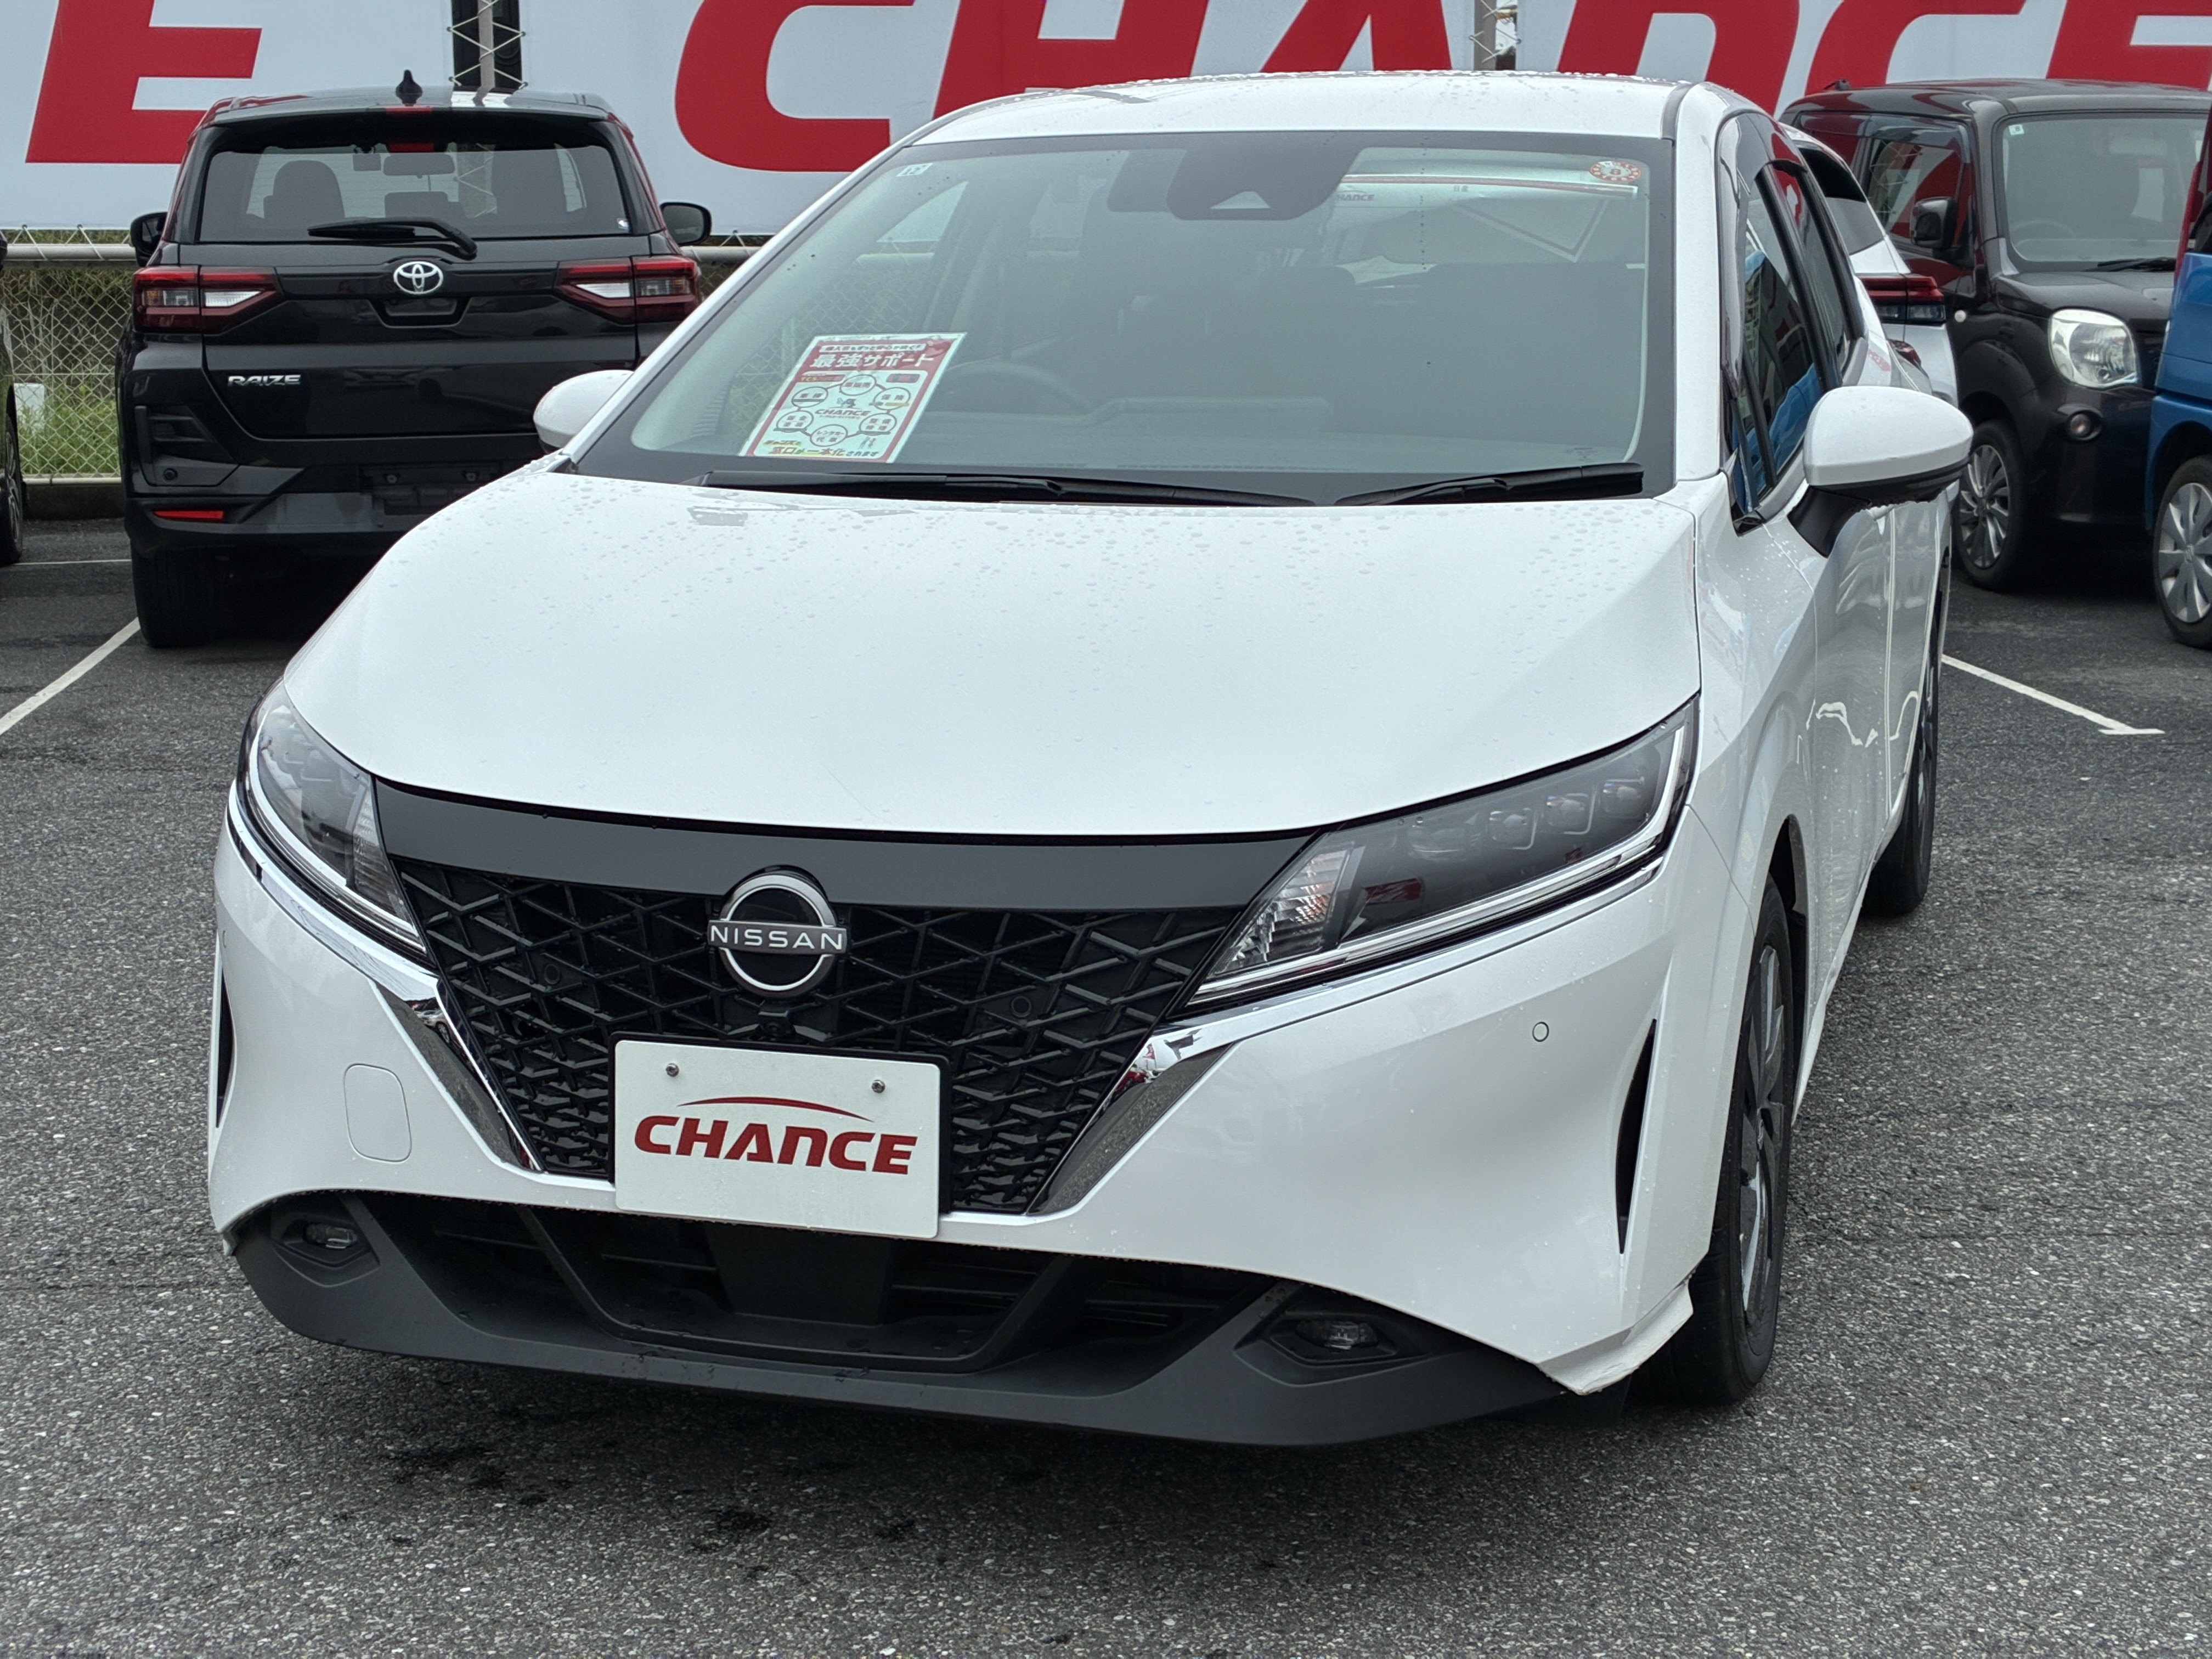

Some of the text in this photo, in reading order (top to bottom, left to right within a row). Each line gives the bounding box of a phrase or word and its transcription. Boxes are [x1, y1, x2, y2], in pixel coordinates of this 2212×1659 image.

[811, 353, 934, 368] 最強サポート
[227, 374, 301, 387] RAIZE
[710, 924, 843, 950] NISSAN
[634, 1115, 918, 1175] CHANCE
